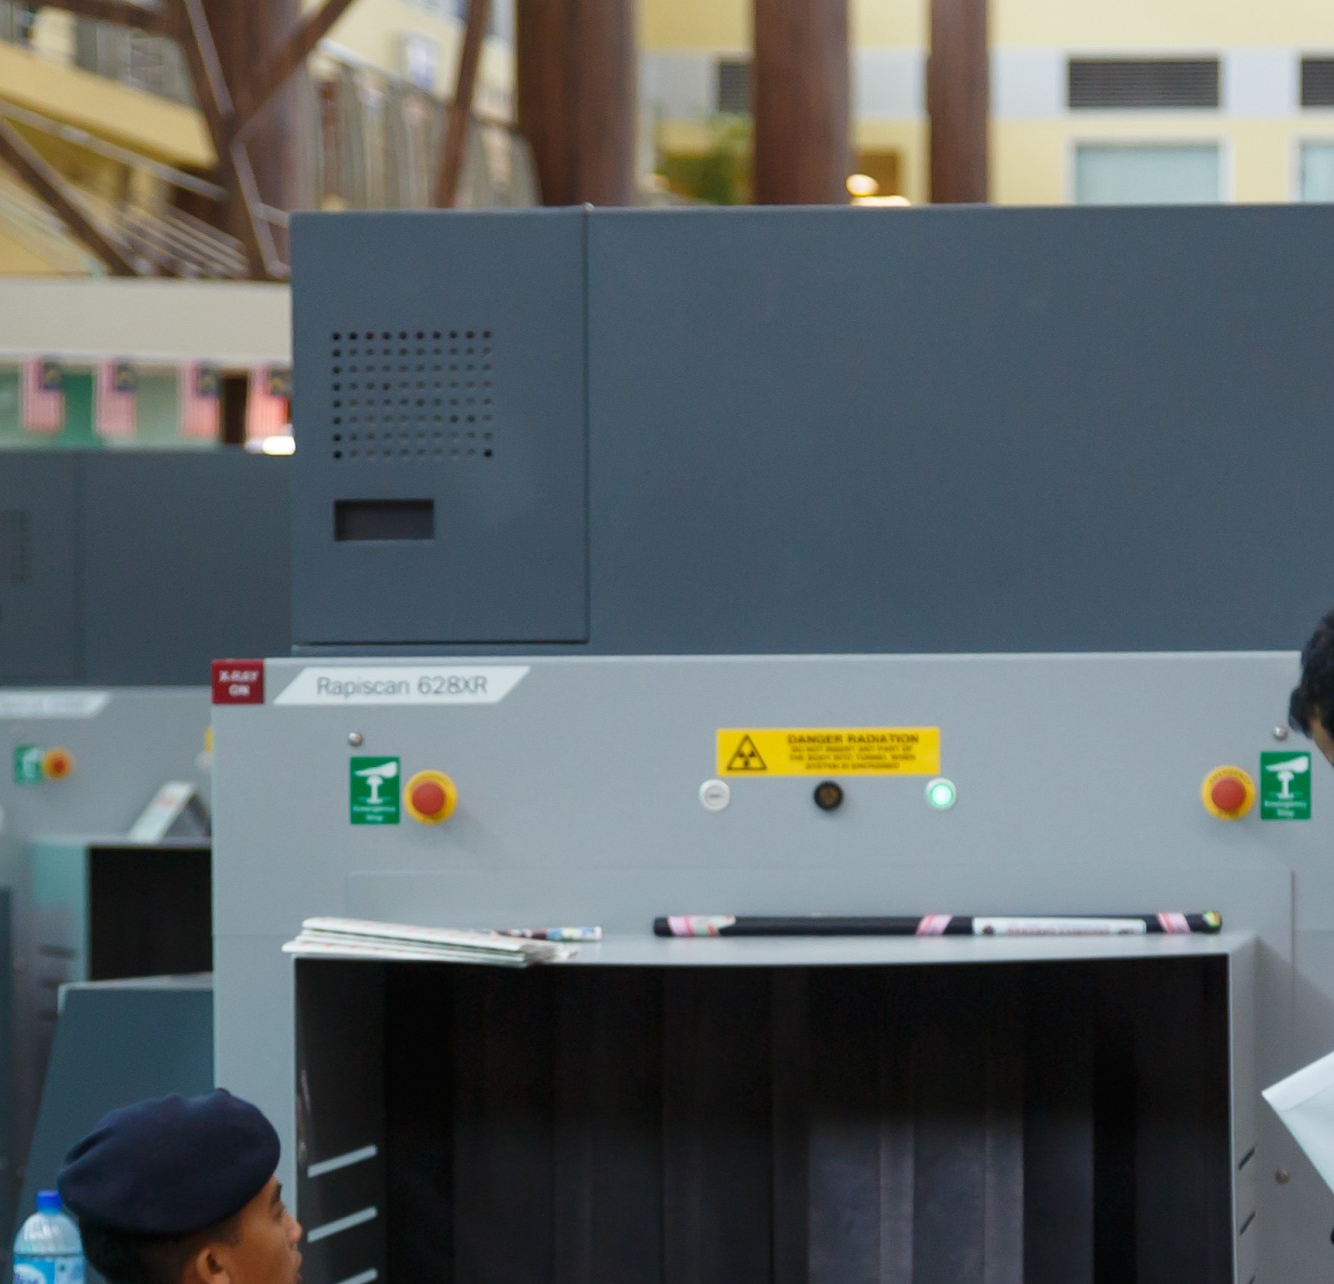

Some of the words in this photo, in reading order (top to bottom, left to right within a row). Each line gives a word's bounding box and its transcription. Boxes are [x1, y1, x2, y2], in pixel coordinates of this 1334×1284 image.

[317, 676, 410, 698] Rapiscan
[417, 675, 488, 695] 628XR
[787, 733, 843, 744] DANGER
[848, 733, 919, 744] RADIATION
